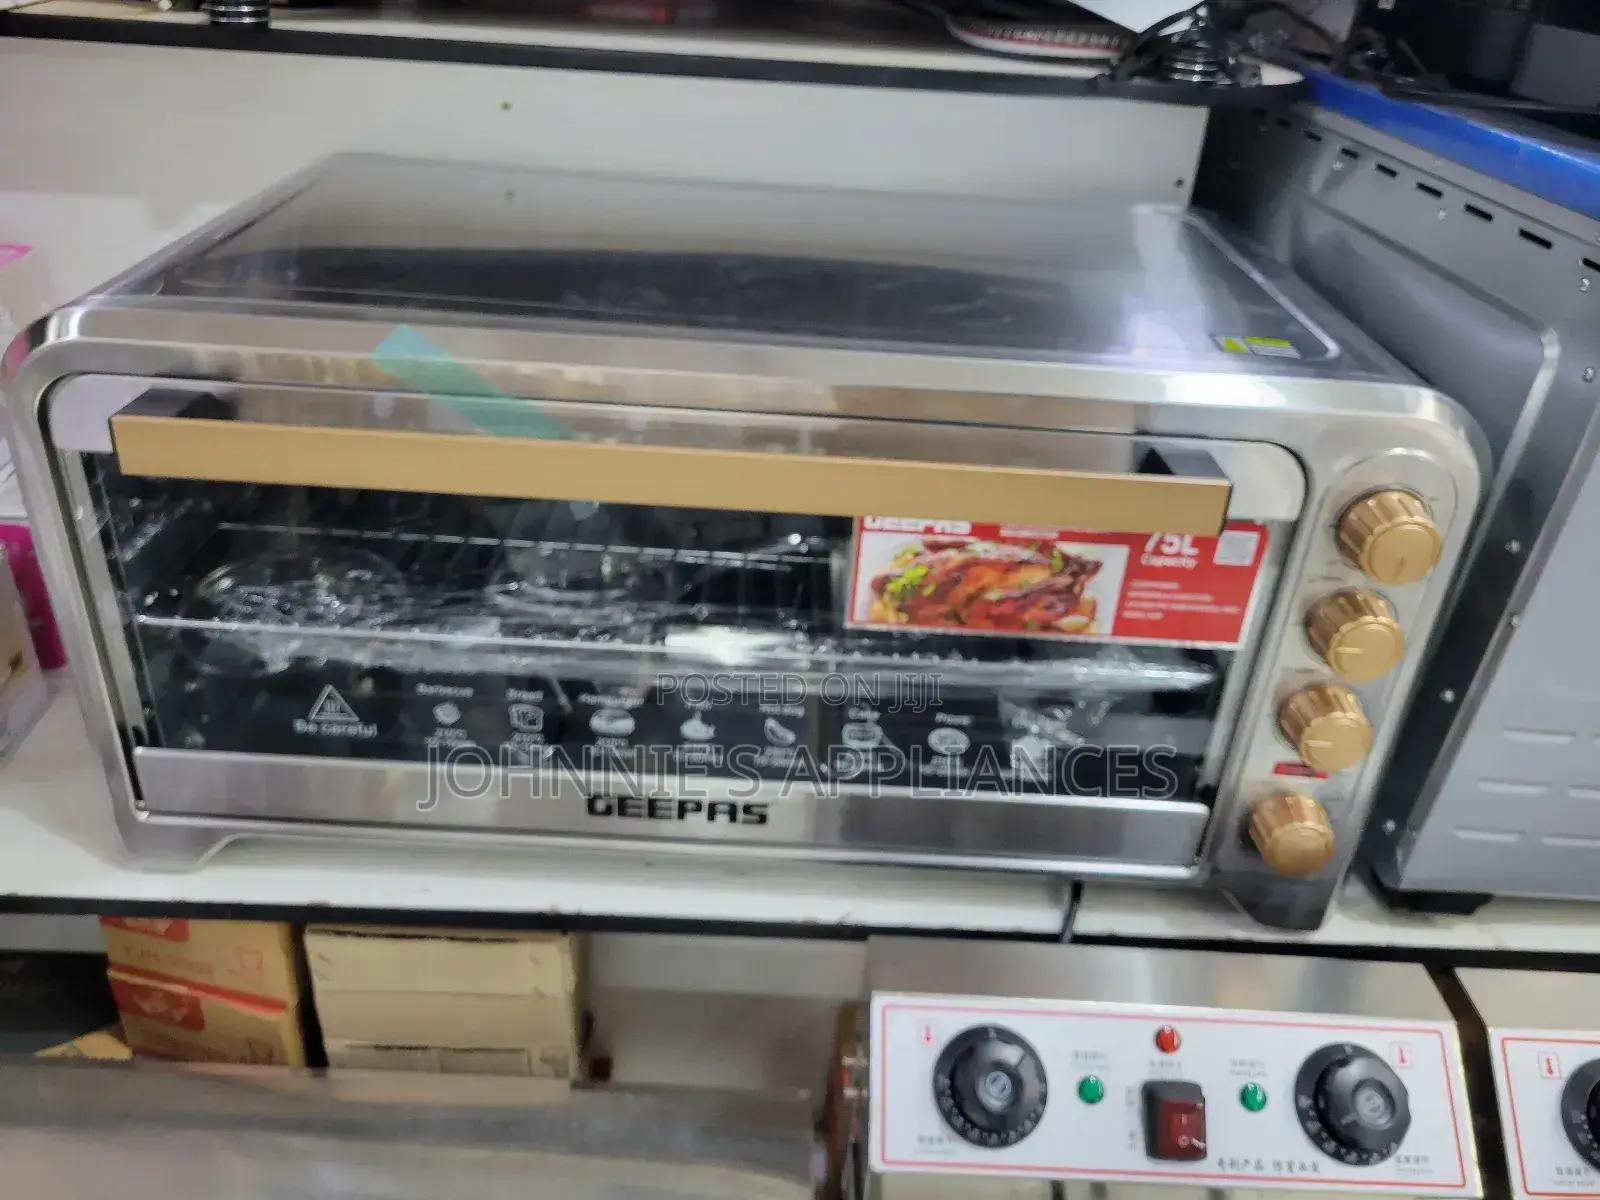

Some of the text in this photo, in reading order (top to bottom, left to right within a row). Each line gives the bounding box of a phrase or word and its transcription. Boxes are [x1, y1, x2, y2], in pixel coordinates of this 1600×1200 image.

[292, 718, 378, 739] Be careful
[586, 795, 770, 825] GEEPAS
